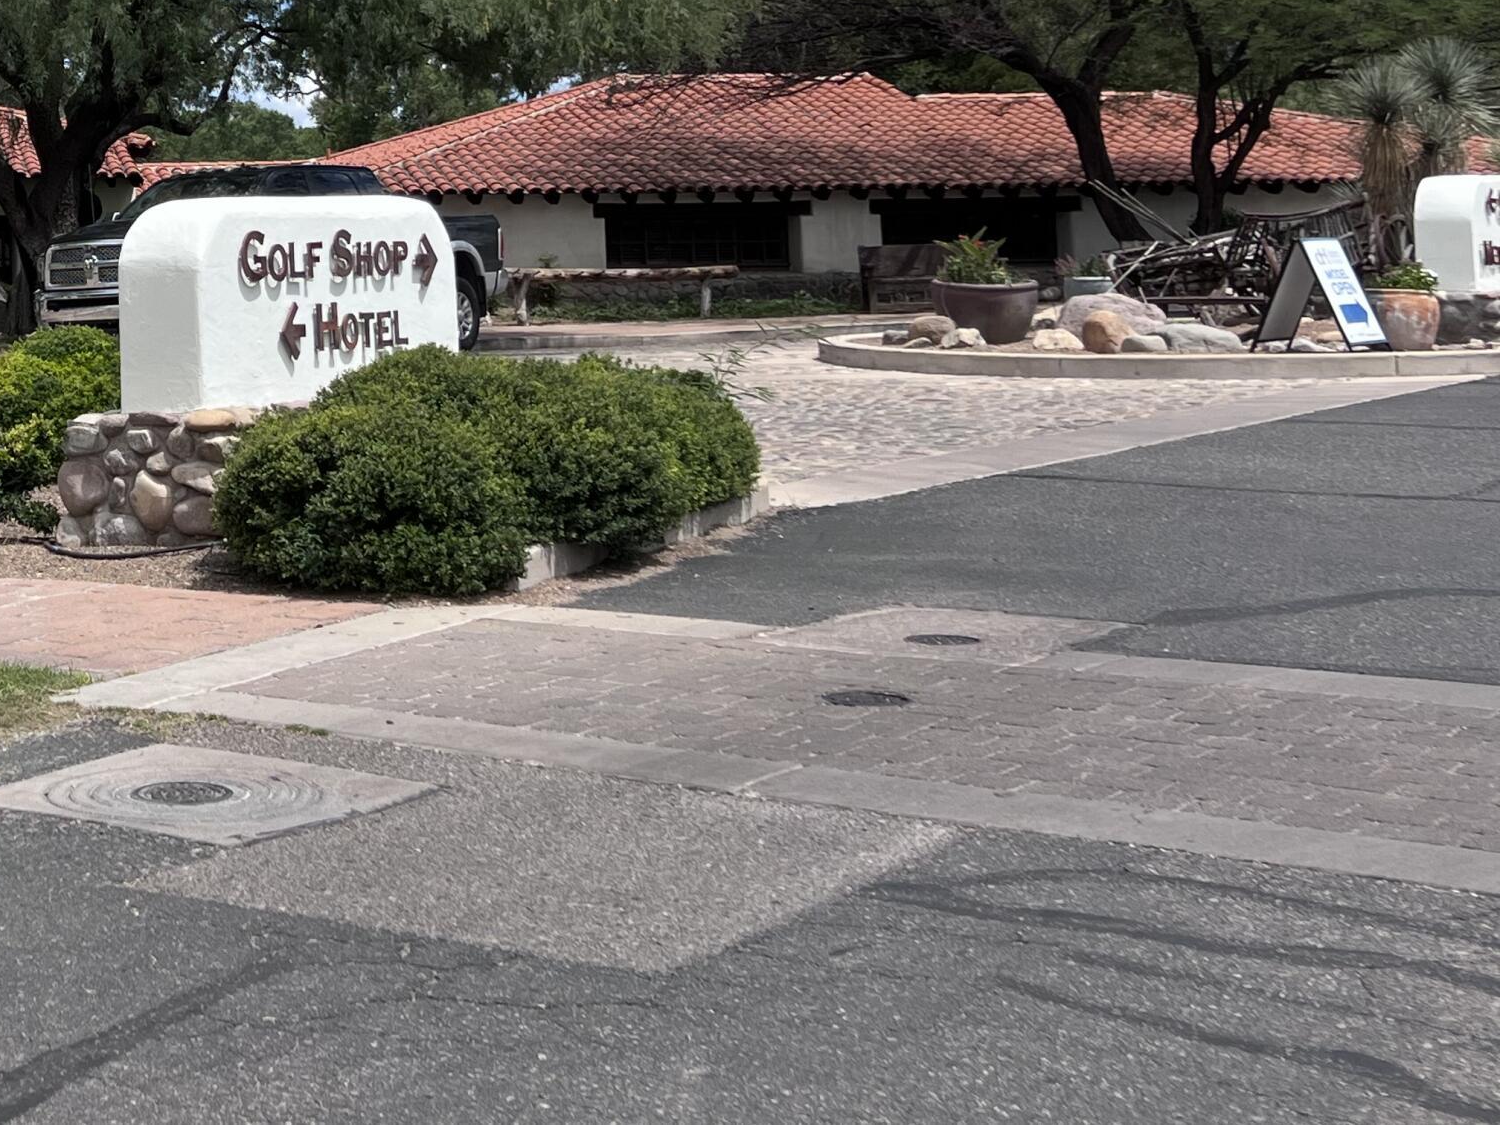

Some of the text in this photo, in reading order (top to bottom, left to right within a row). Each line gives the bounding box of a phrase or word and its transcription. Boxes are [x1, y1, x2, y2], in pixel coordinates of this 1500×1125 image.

[240, 229, 409, 283] GOLF SHOP
[314, 302, 409, 352] HOTEL
